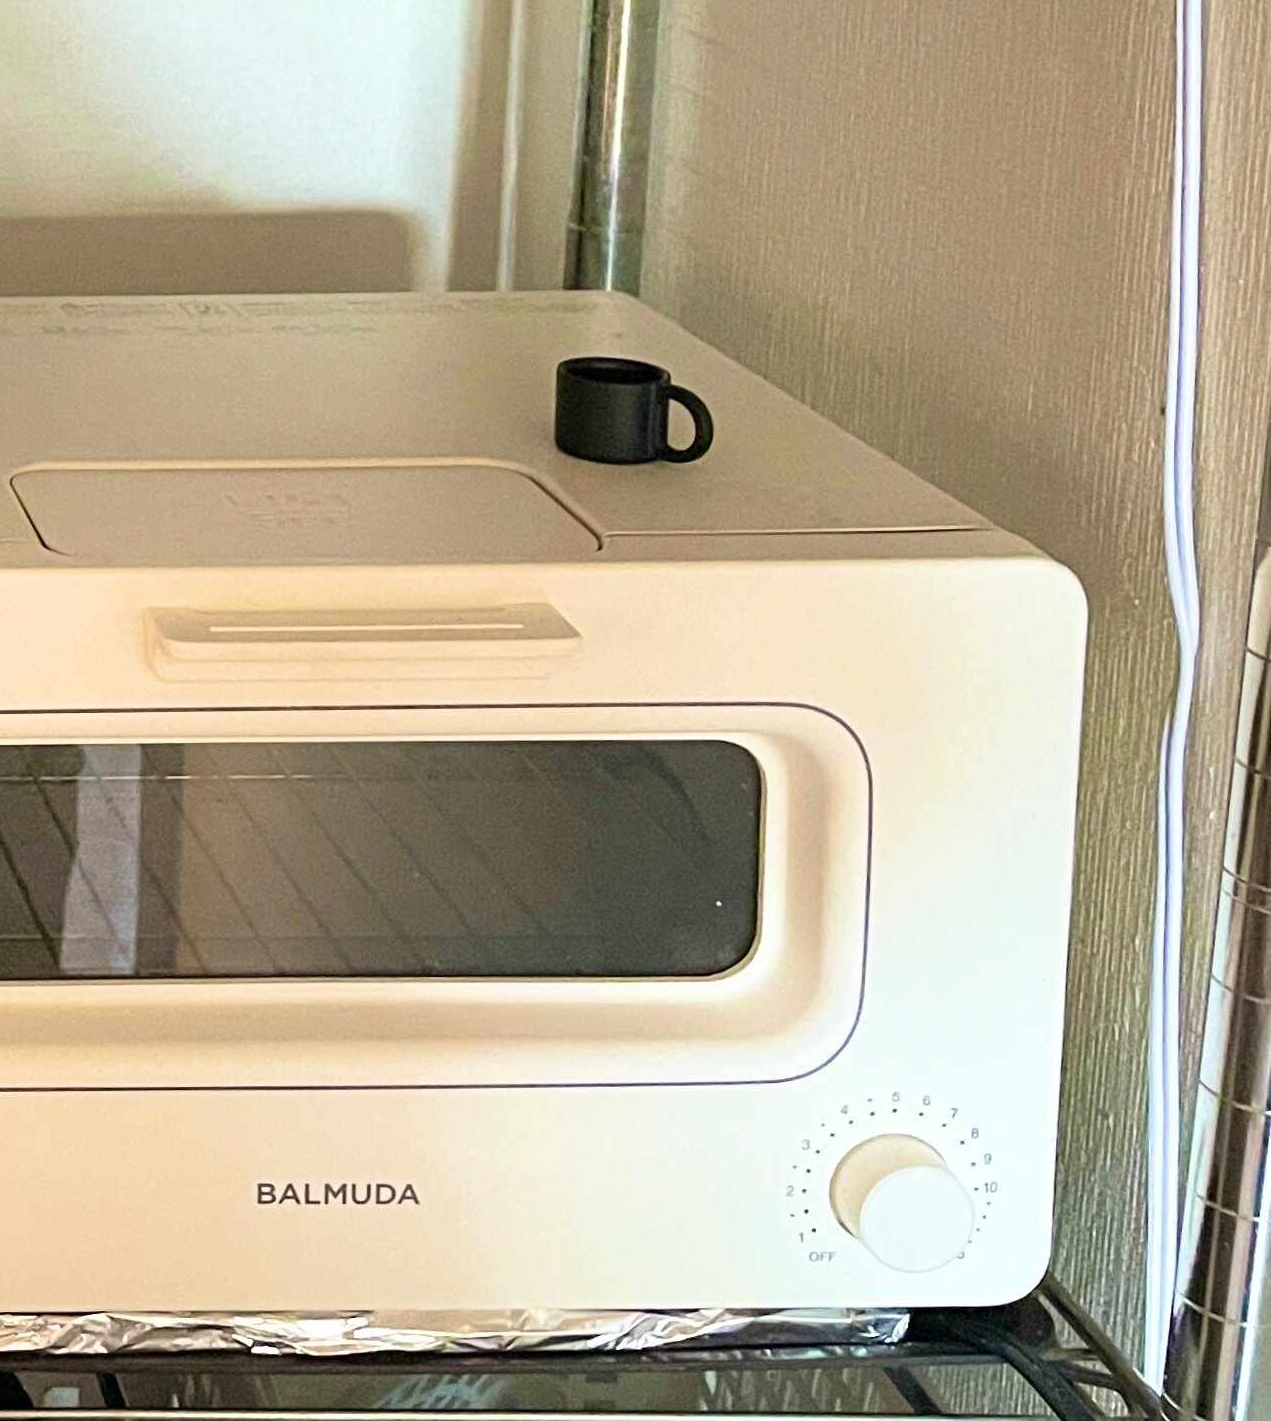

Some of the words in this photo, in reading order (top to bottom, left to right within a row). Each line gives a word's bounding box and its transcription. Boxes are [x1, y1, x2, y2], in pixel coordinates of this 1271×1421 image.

[891, 1092, 900, 1102] 5
[922, 1095, 931, 1106] 6
[840, 1105, 849, 1115] 4
[950, 1107, 959, 1118] 7
[971, 1128, 980, 1139] 8
[801, 1139, 810, 1151] 3
[983, 1153, 992, 1164] 9
[786, 1185, 795, 1196] 2
[984, 1182, 998, 1193] 10
[256, 1182, 420, 1206] BALMUDA
[798, 1233, 804, 1243] 1
[809, 1251, 836, 1262] OFF
